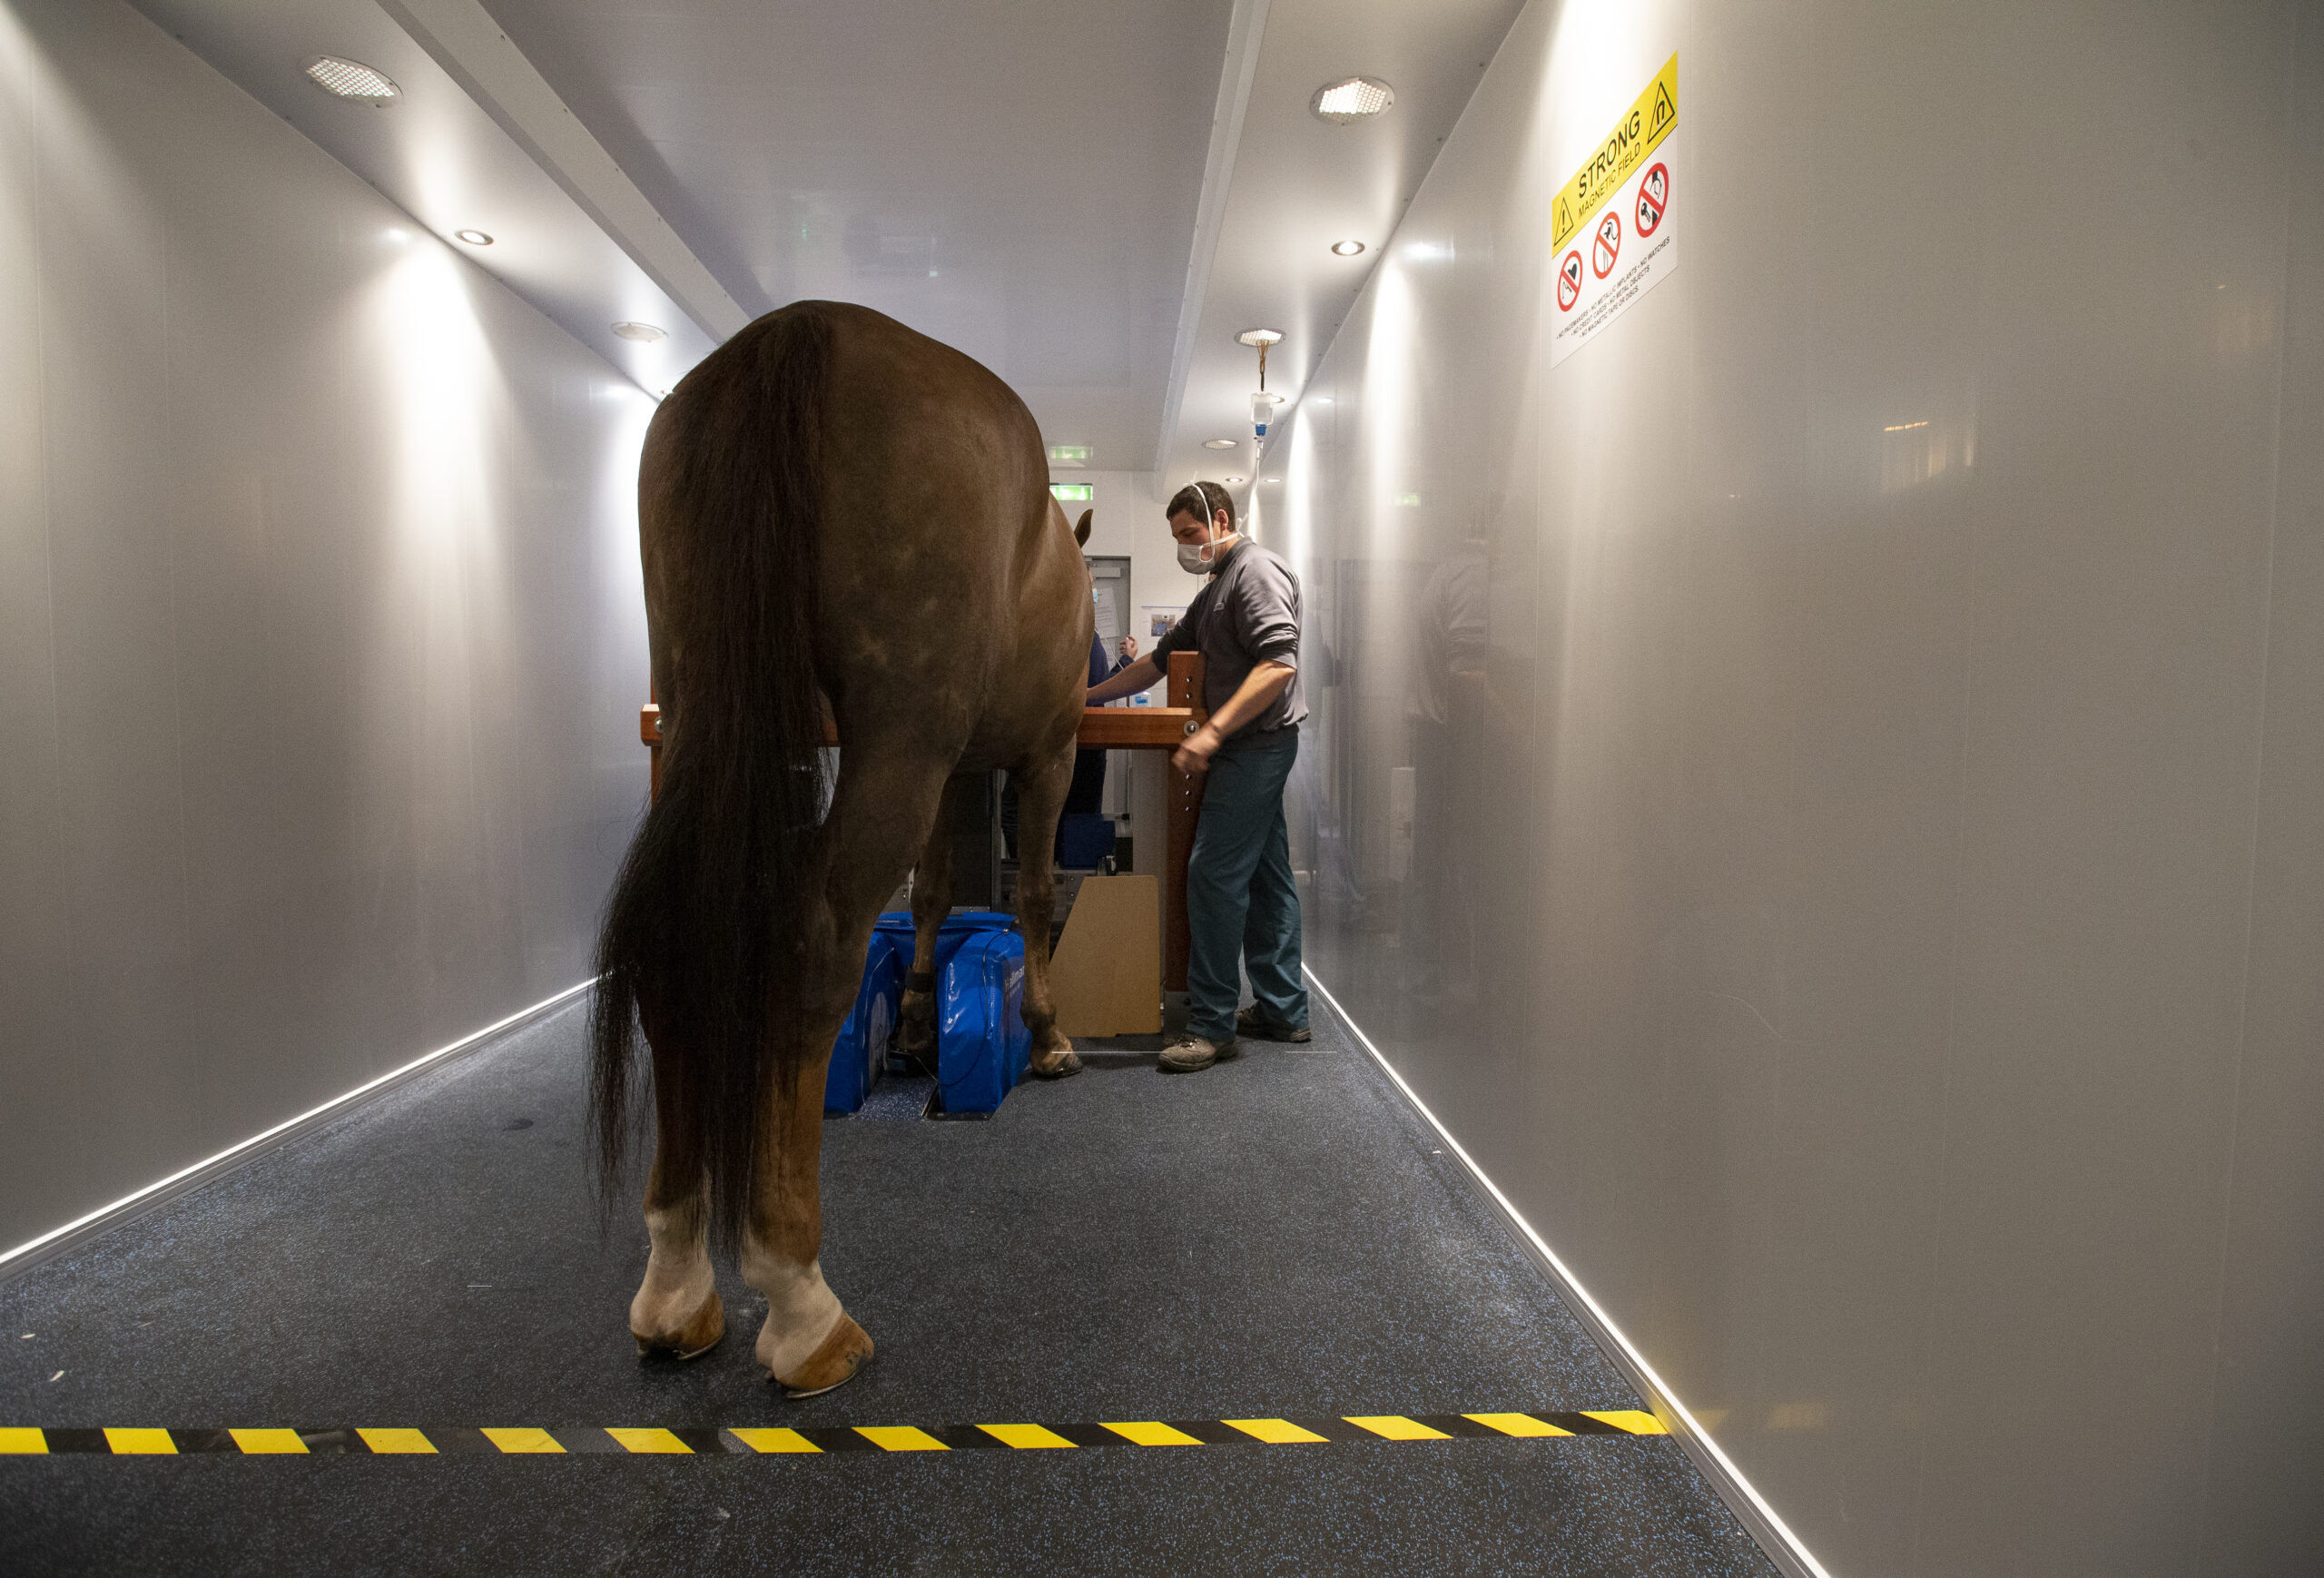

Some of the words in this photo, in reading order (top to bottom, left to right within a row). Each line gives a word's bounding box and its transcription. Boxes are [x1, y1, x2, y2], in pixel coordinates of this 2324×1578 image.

[1578, 170, 1617, 218] MAGNETIC
[1618, 142, 1640, 178] FIELD
[1579, 110, 1640, 199] STRONG
[1648, 236, 1670, 261] WATCHES
[1580, 314, 1592, 330] CREDIT
[1616, 285, 1629, 299] METAL
[1630, 264, 1649, 286] OBJECTS
